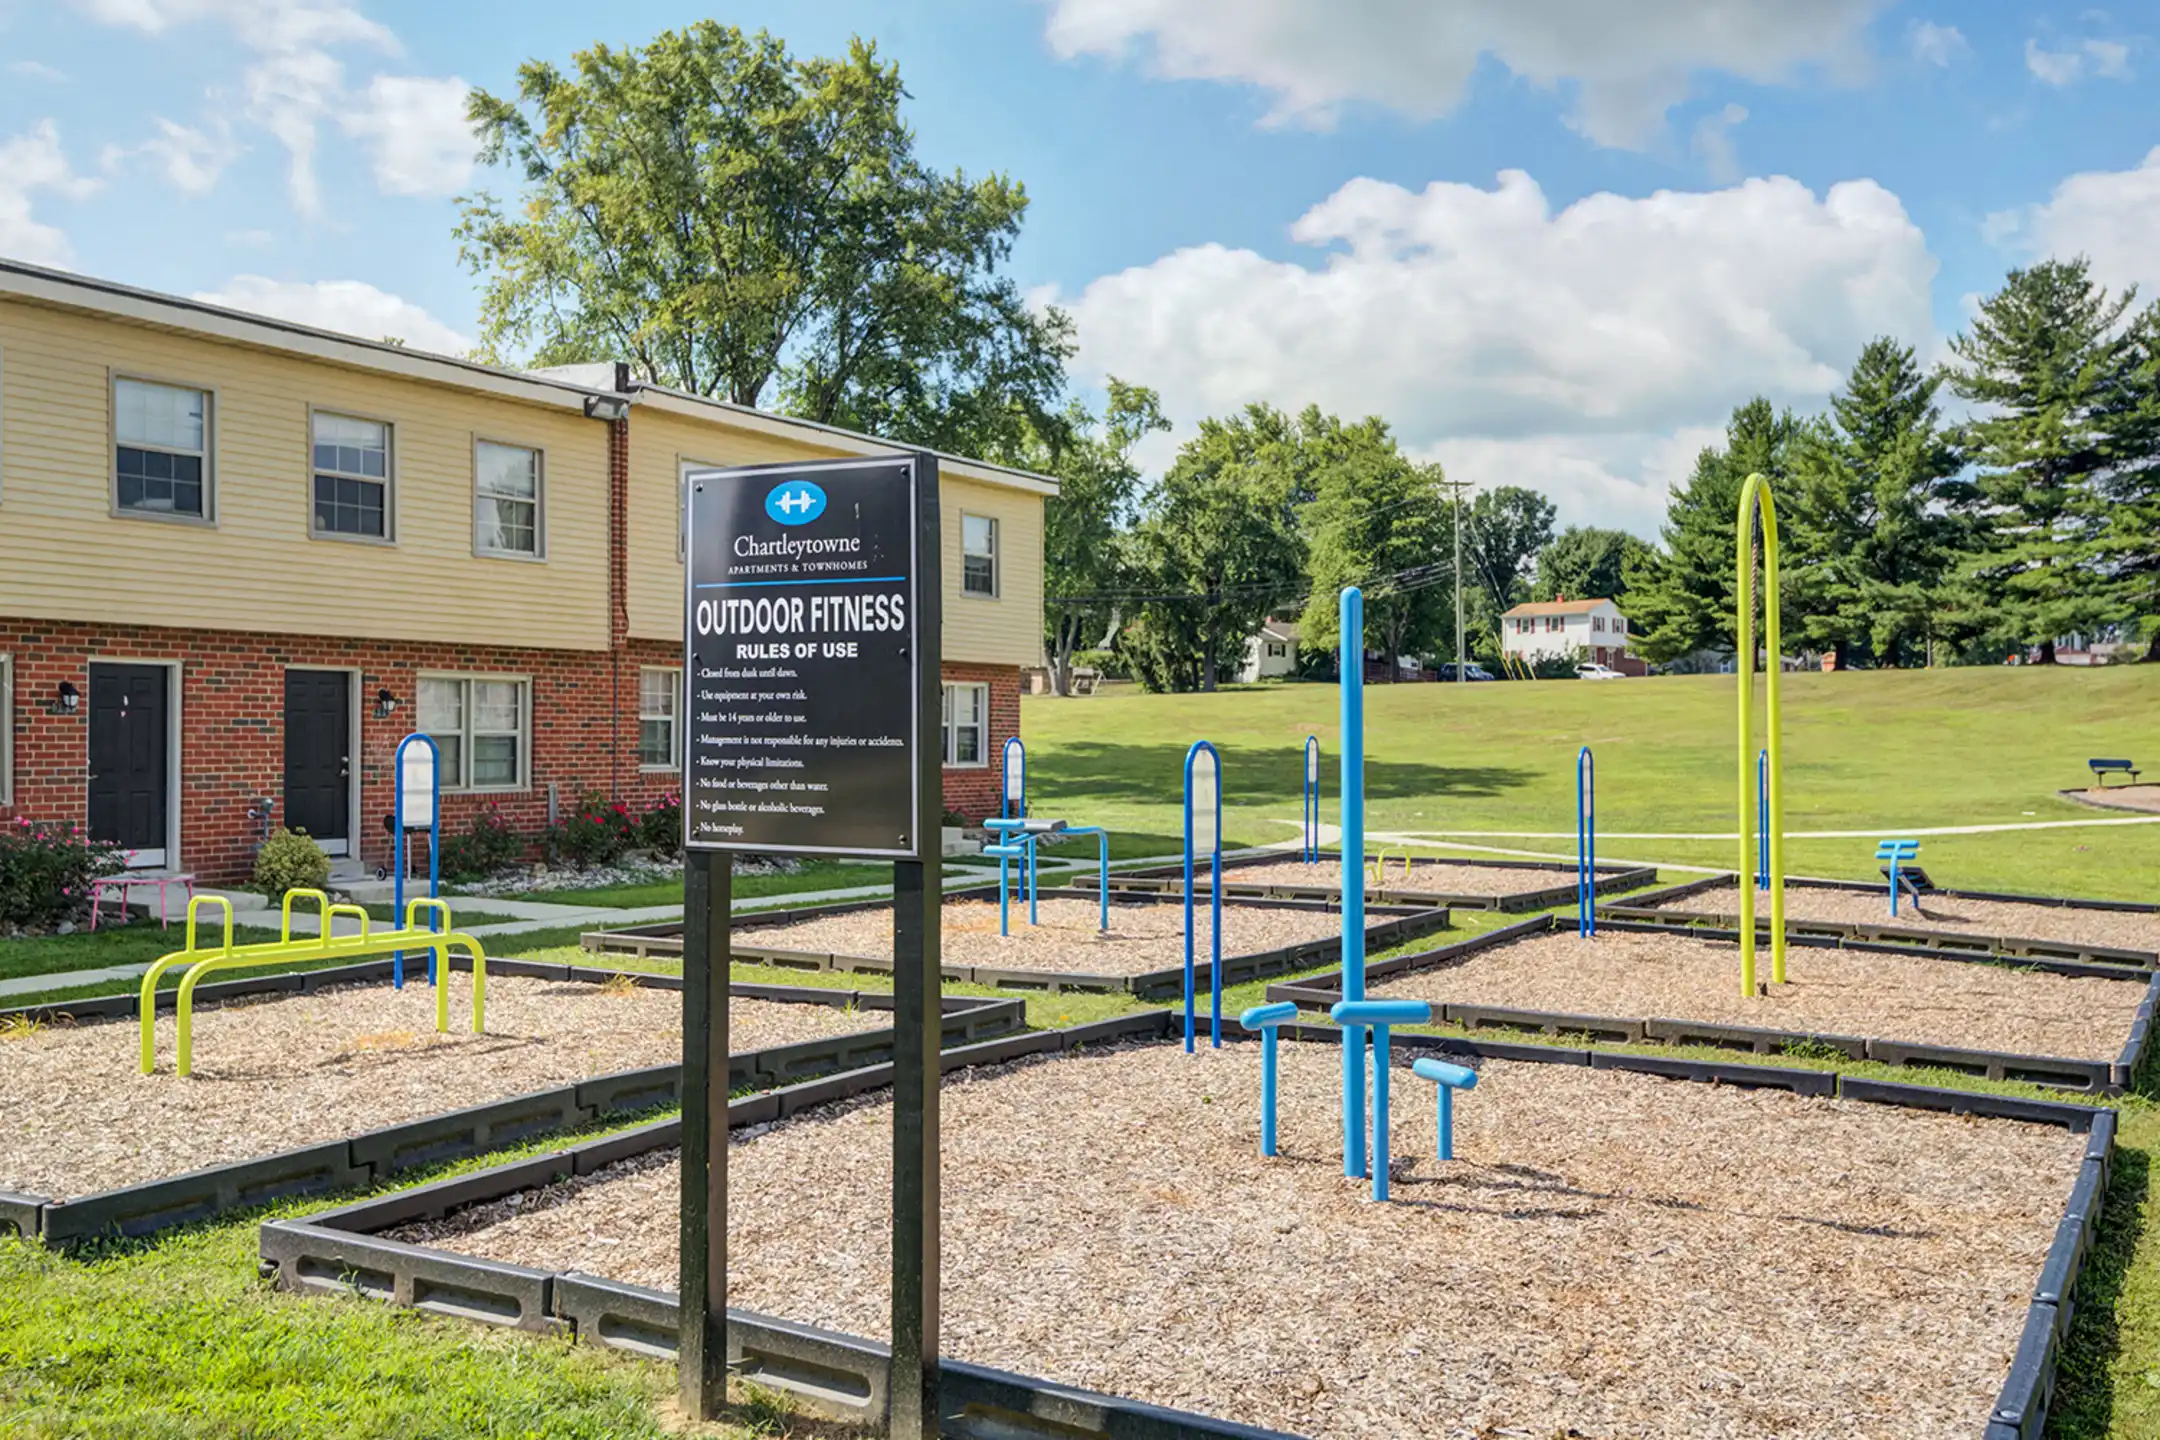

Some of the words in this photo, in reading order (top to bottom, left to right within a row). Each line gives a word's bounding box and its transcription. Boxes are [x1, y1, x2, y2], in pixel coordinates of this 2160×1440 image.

[734, 534, 860, 560] Chartleytowne
[728, 564, 789, 575] APARTMENTS
[802, 561, 868, 571] TOWNHOMES
[696, 597, 804, 635] OUTDOOR
[811, 594, 904, 633] FITNESS
[736, 643, 790, 659] RULES
[795, 643, 815, 658] OF
[823, 642, 858, 658] USE
[701, 668, 722, 678] Closed
[724, 667, 740, 677] from
[742, 667, 757, 678] dusk
[759, 667, 775, 677] until
[777, 667, 797, 677] dawn.
[701, 690, 713, 699] Use
[714, 690, 749, 702] equipment
[758, 692, 773, 702] your
[792, 689, 807, 699] risk.
[701, 712, 717, 722] Must
[718, 713, 726, 722] be
[728, 713, 736, 721] 14
[738, 714, 754, 724] years
[765, 713, 783, 722] older
[700, 734, 742, 746] Management
[744, 735, 749, 744] is
[764, 735, 802, 747] responsible
[803, 735, 814, 745] for
[815, 737, 828, 748] any
[830, 737, 856, 748] injuries
[858, 738, 866, 746] or
[868, 736, 904, 746] accidents.
[700, 756, 719, 766] Know
[720, 759, 736, 768] your
[737, 757, 763, 769] physical
[765, 757, 804, 767] limitations.
[700, 778, 710, 788] No
[712, 778, 726, 788] food
[737, 779, 768, 792] beverages
[770, 780, 788, 790] other
[790, 780, 805, 790] than
[807, 783, 828, 791] water.
[700, 800, 711, 809] No
[728, 800, 747, 811] bottle
[758, 802, 788, 812] alcoholic
[790, 801, 825, 816] beverages.
[700, 822, 711, 832] No
